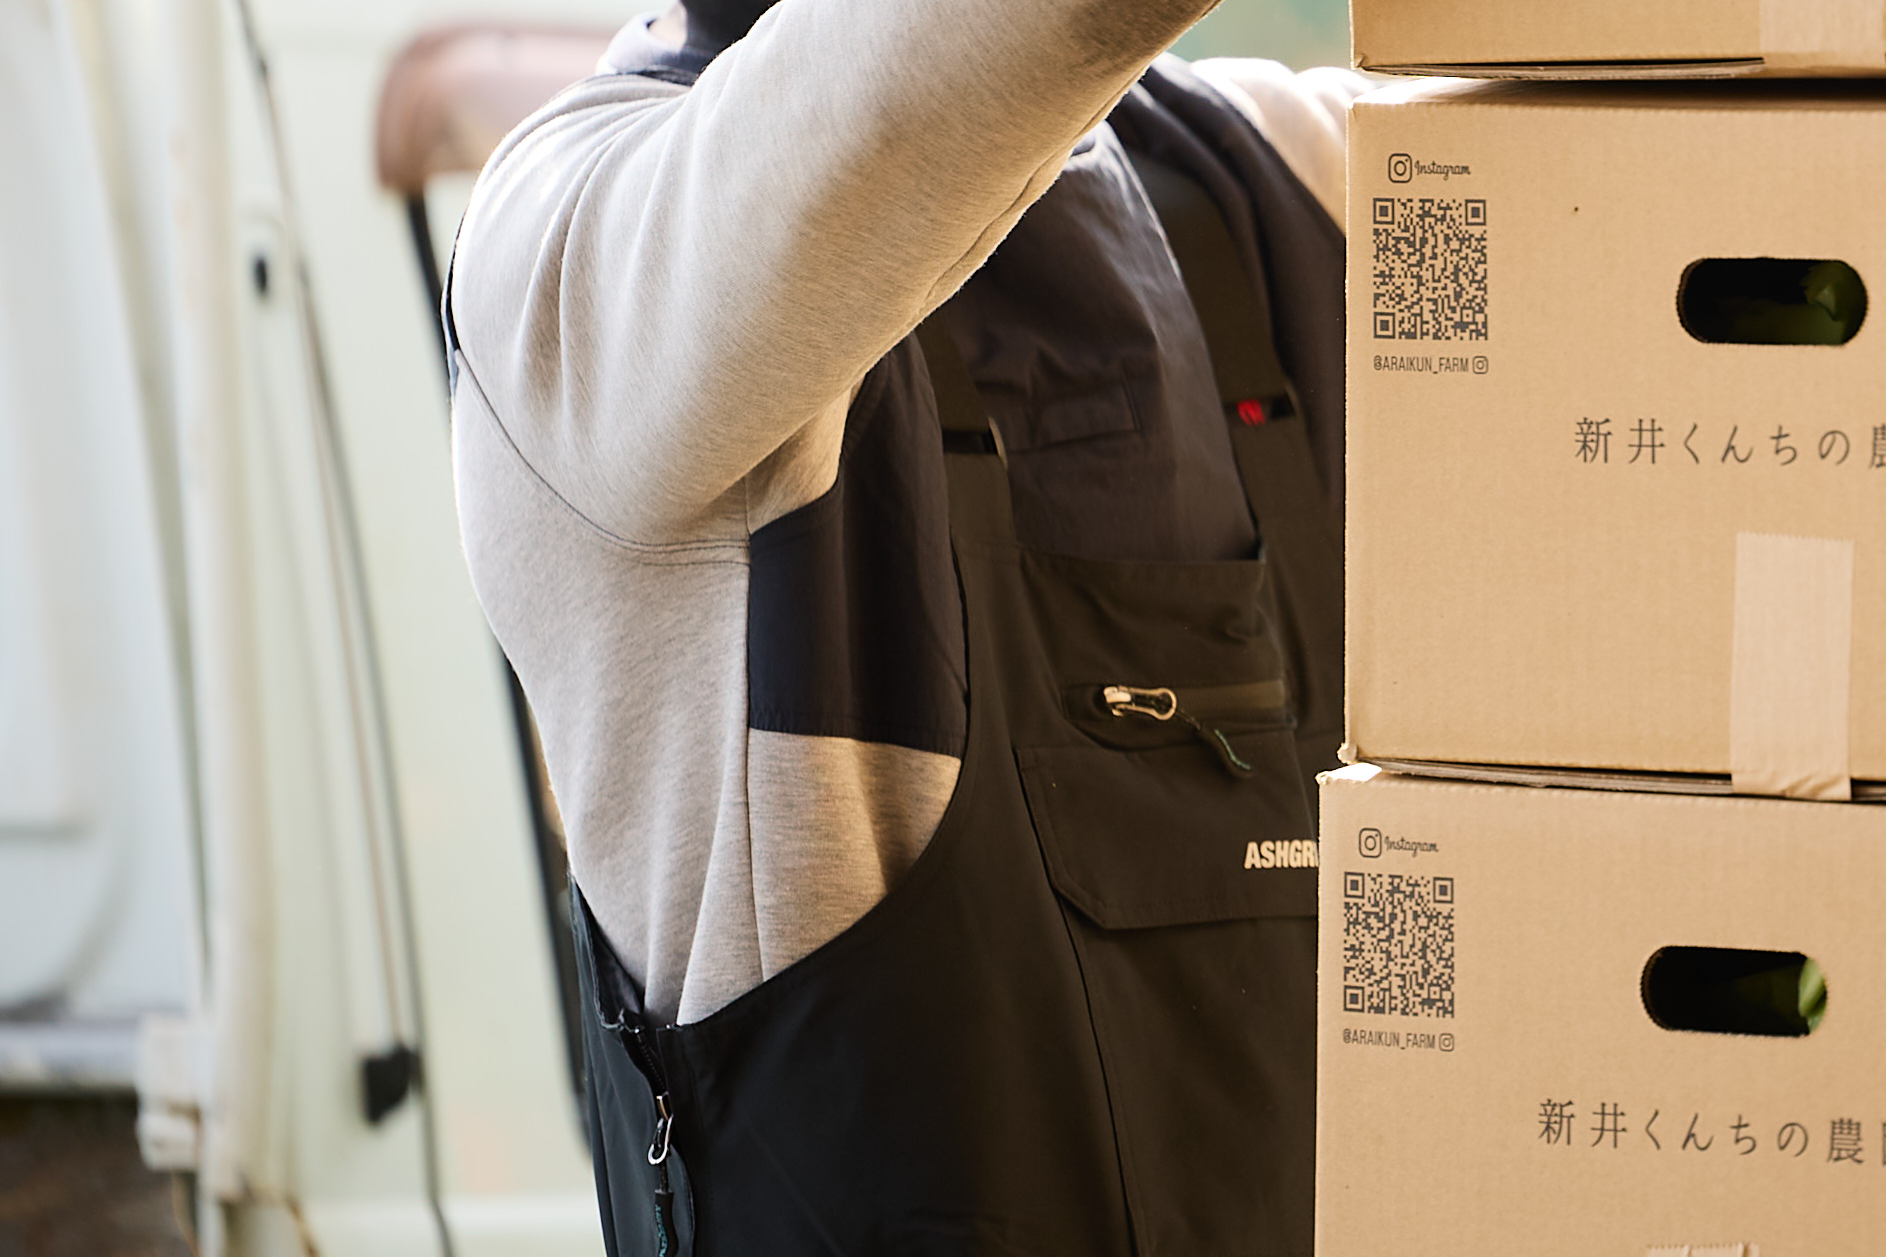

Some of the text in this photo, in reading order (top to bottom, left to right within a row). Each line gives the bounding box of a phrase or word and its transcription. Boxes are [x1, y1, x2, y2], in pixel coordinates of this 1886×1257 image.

[1414, 160, 1471, 181] Instagram
[1374, 355, 1469, 374] @ARAIKUN_FARM
[1384, 836, 1439, 857] Instagram
[1343, 1028, 1435, 1050] @ARAIKUN_FARM
